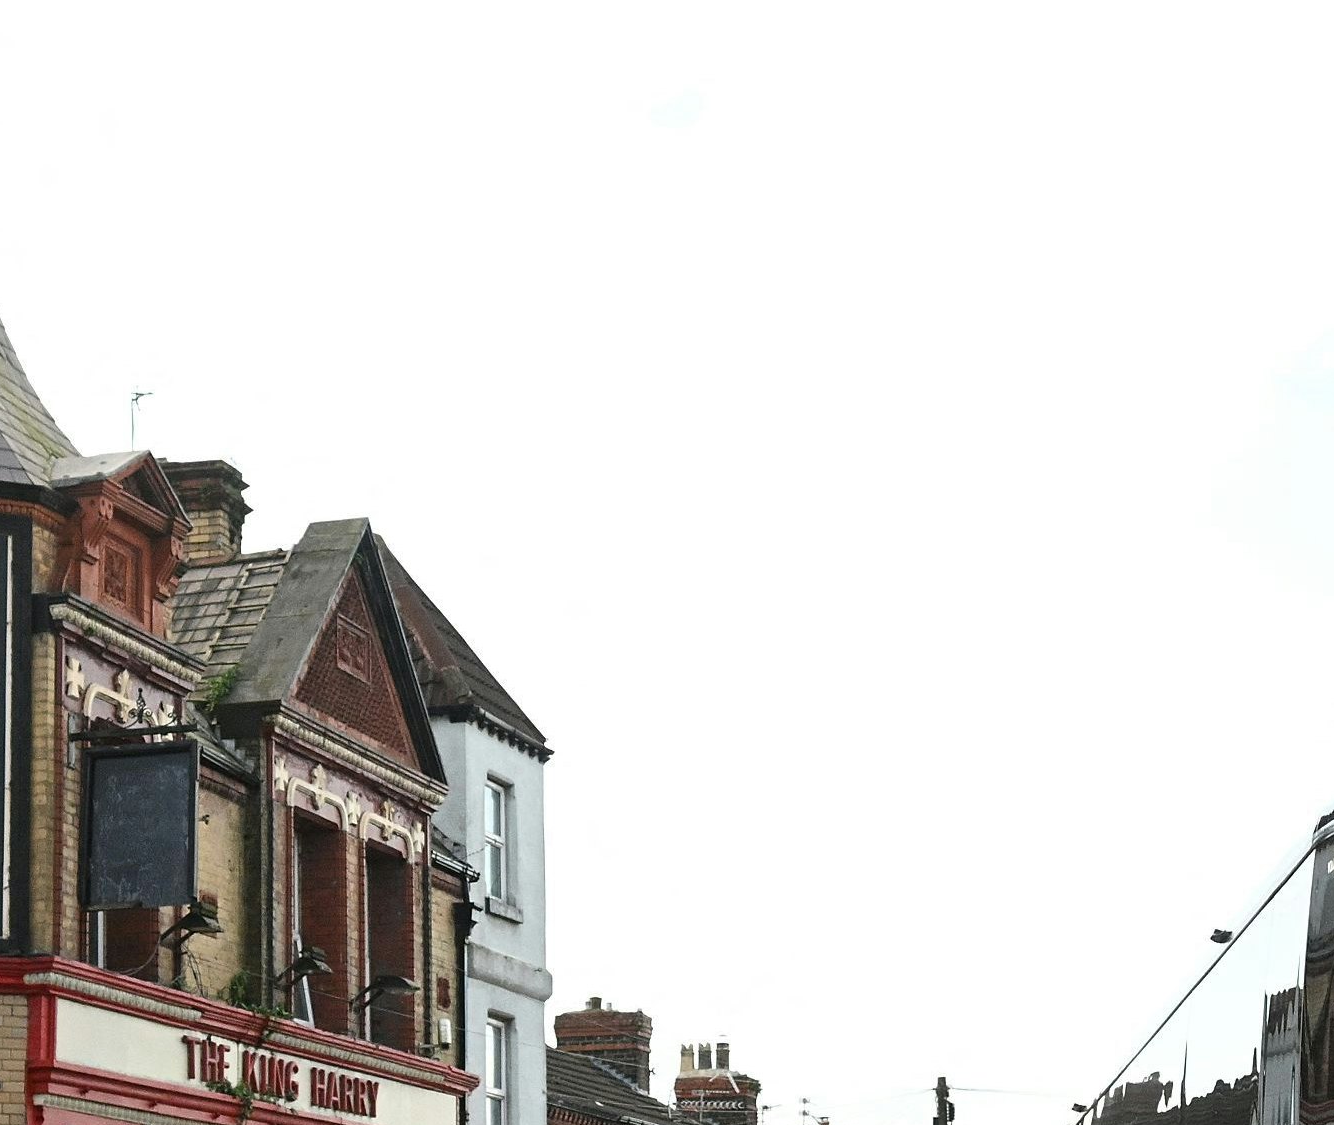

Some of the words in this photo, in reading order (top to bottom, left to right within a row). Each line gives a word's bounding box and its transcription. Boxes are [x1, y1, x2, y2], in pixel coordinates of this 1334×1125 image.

[181, 1035, 231, 1083] THE
[241, 1050, 299, 1102] KING
[310, 1066, 380, 1118] HARRY
